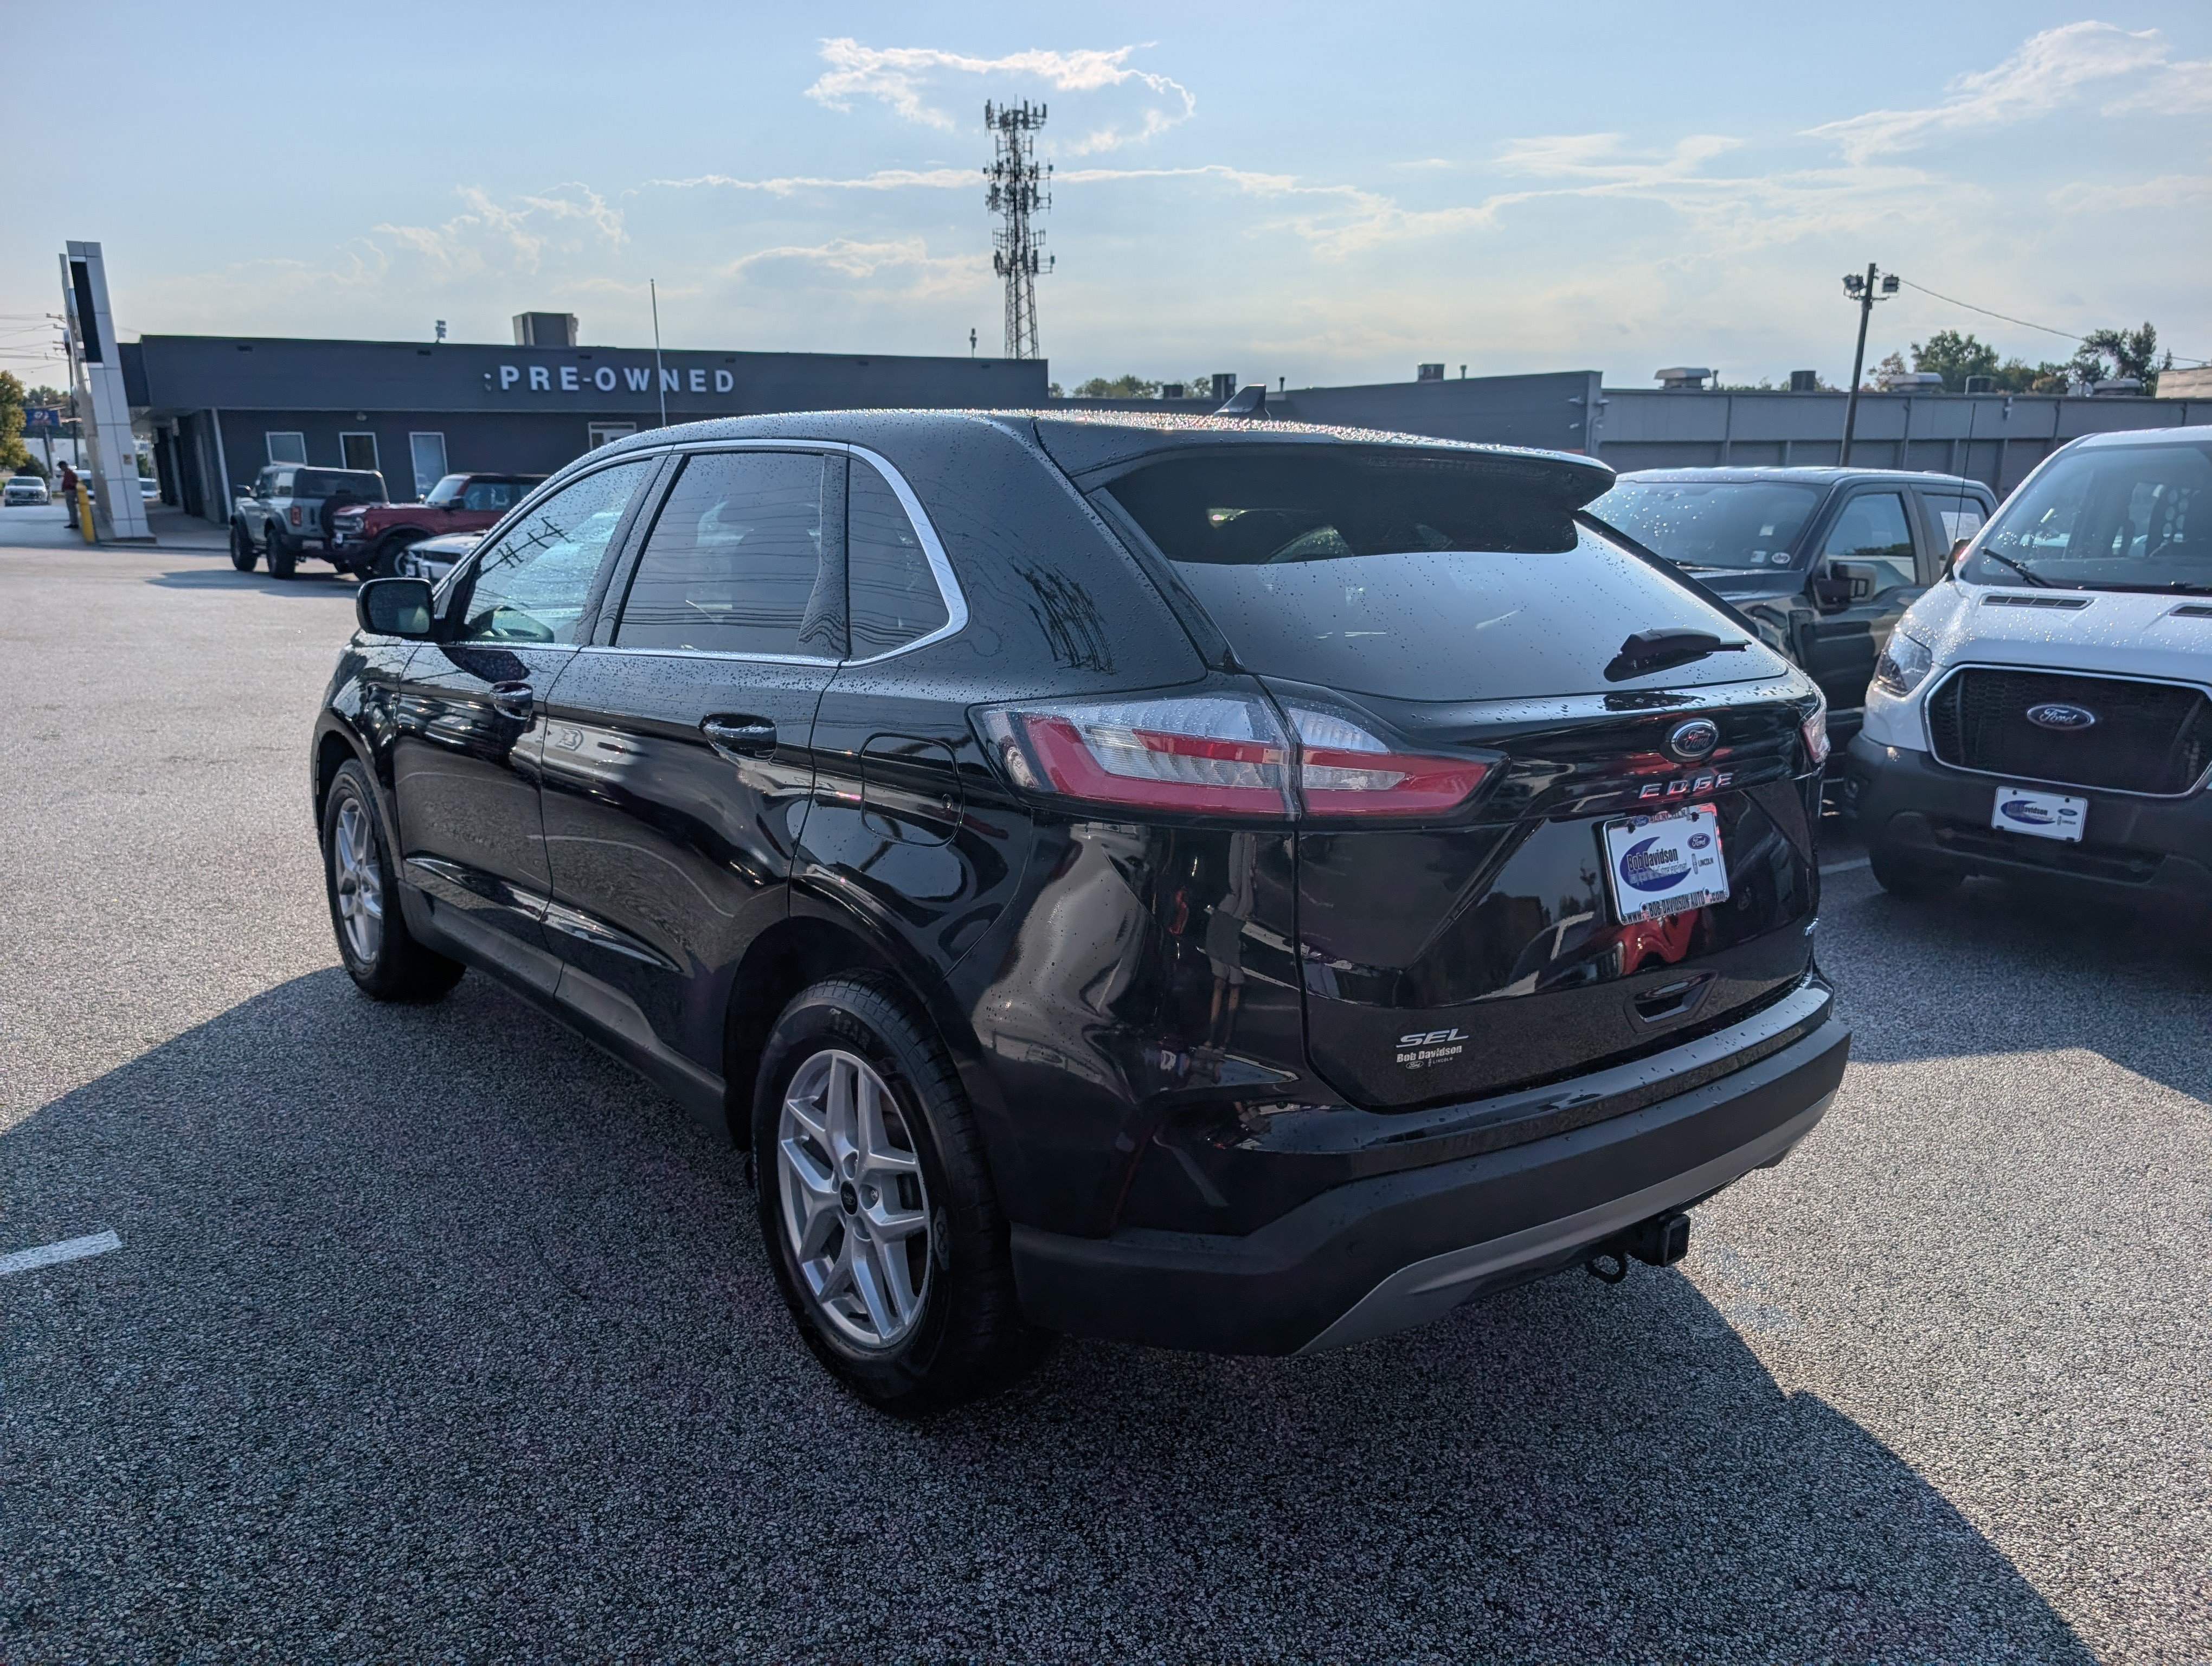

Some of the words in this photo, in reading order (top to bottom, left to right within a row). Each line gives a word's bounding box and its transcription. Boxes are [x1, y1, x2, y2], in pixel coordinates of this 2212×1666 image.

[499, 365, 734, 393] PRE-OWNED
[1638, 772, 1734, 799] EDGE
[1626, 854, 1643, 872] Bob
[1643, 848, 1679, 867] Davidson
[1396, 1028, 1469, 1048] SEL
[1396, 1052, 1417, 1063] Bob
[1418, 1045, 1462, 1060] Davidson
